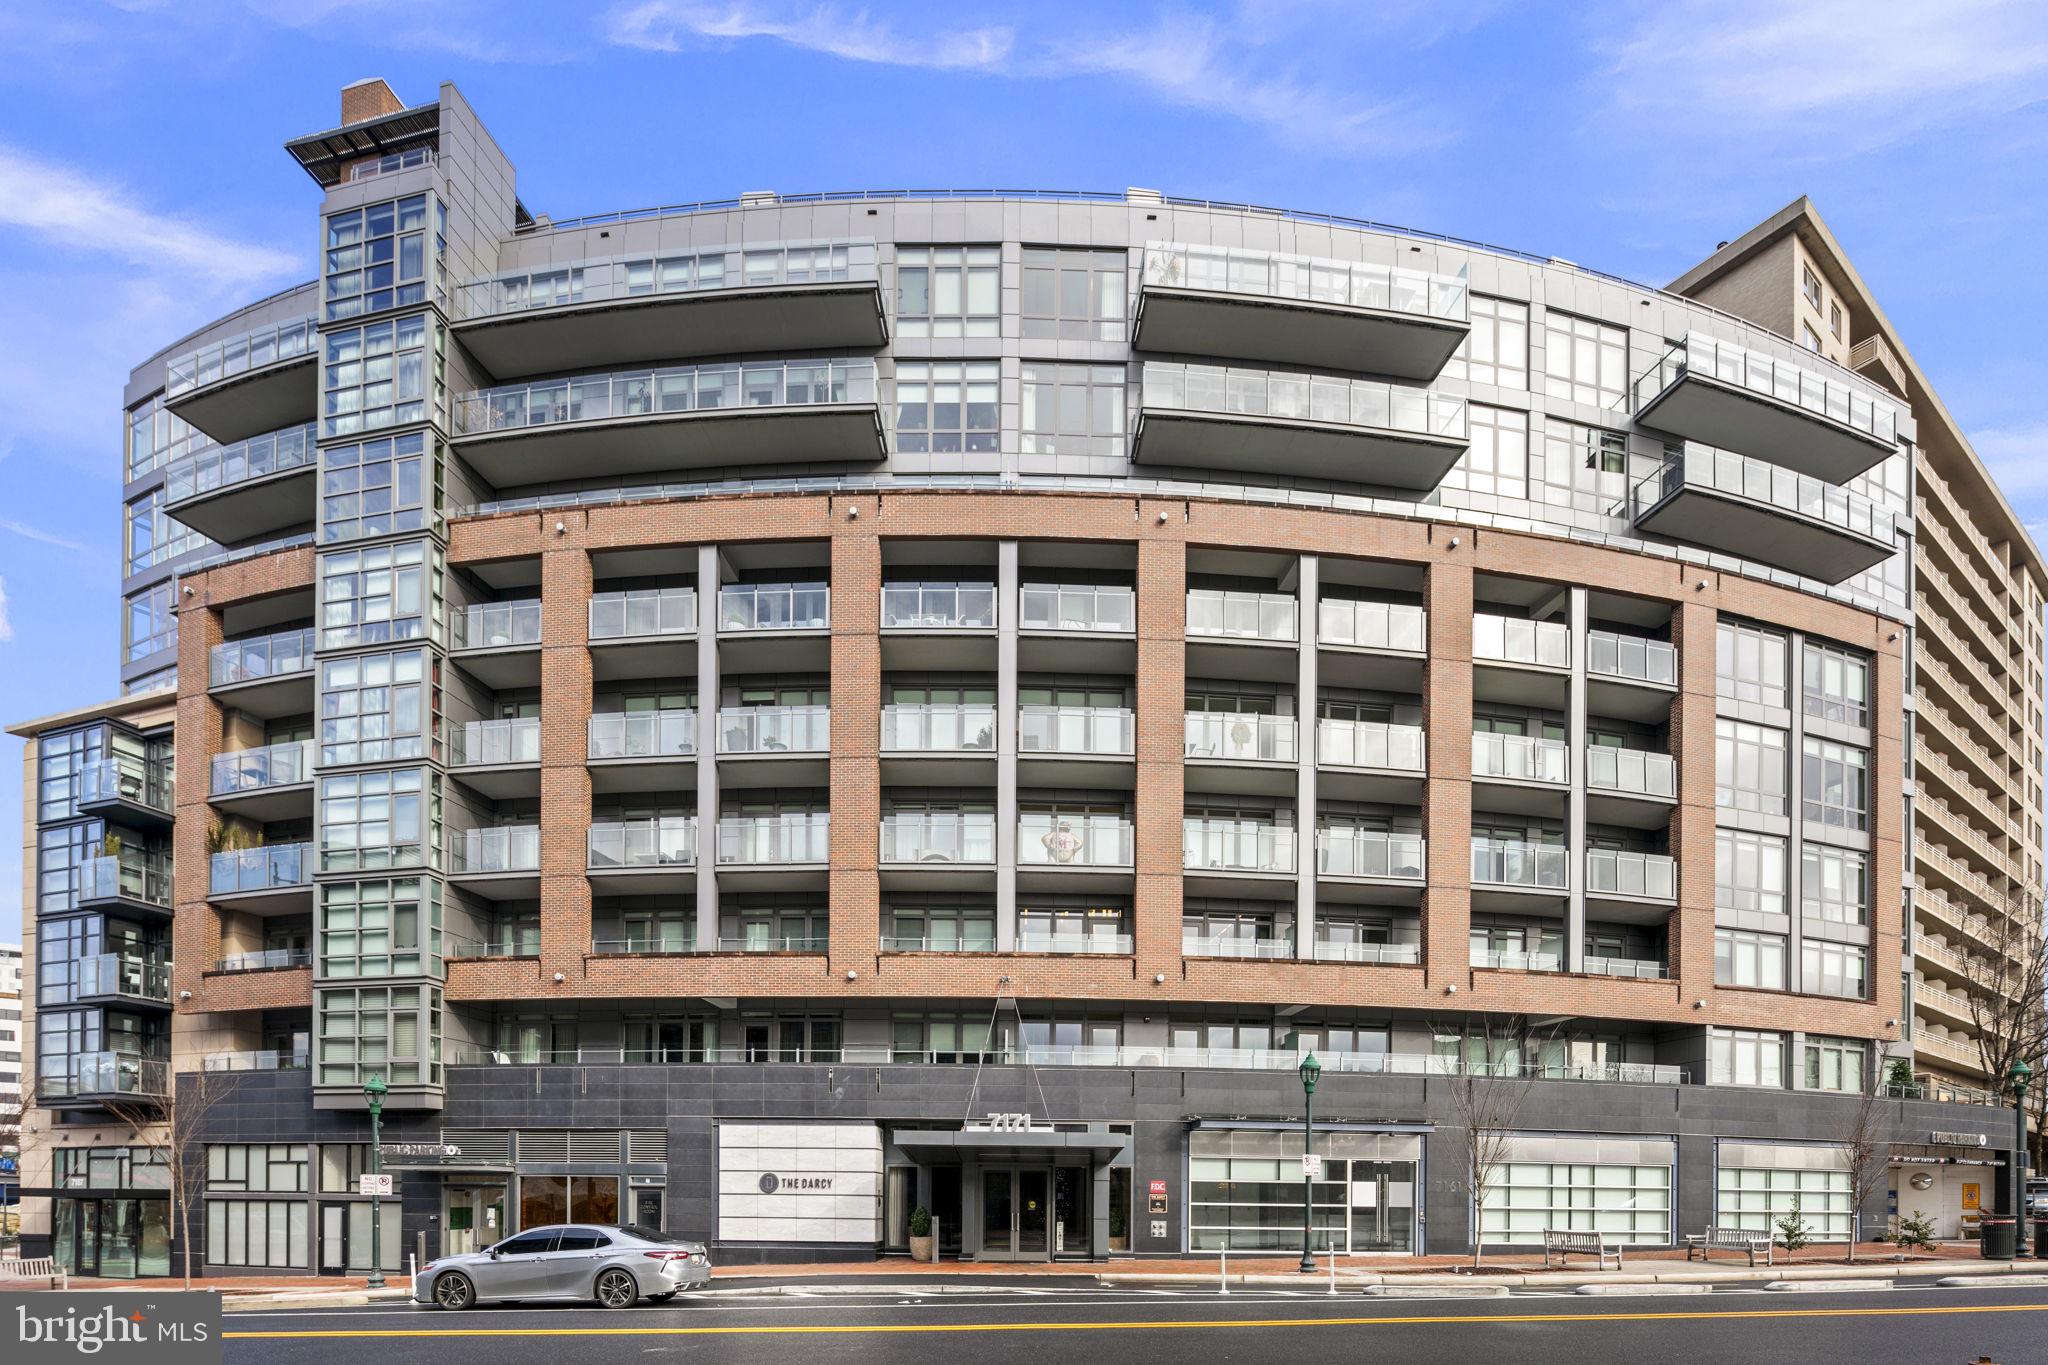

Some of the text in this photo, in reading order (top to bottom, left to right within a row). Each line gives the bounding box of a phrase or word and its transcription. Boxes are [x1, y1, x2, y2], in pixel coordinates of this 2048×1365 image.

[988, 1113, 1031, 1132] 7171
[782, 1178, 833, 1189] THE DARCY
[1435, 1180, 1461, 1193] 7161
